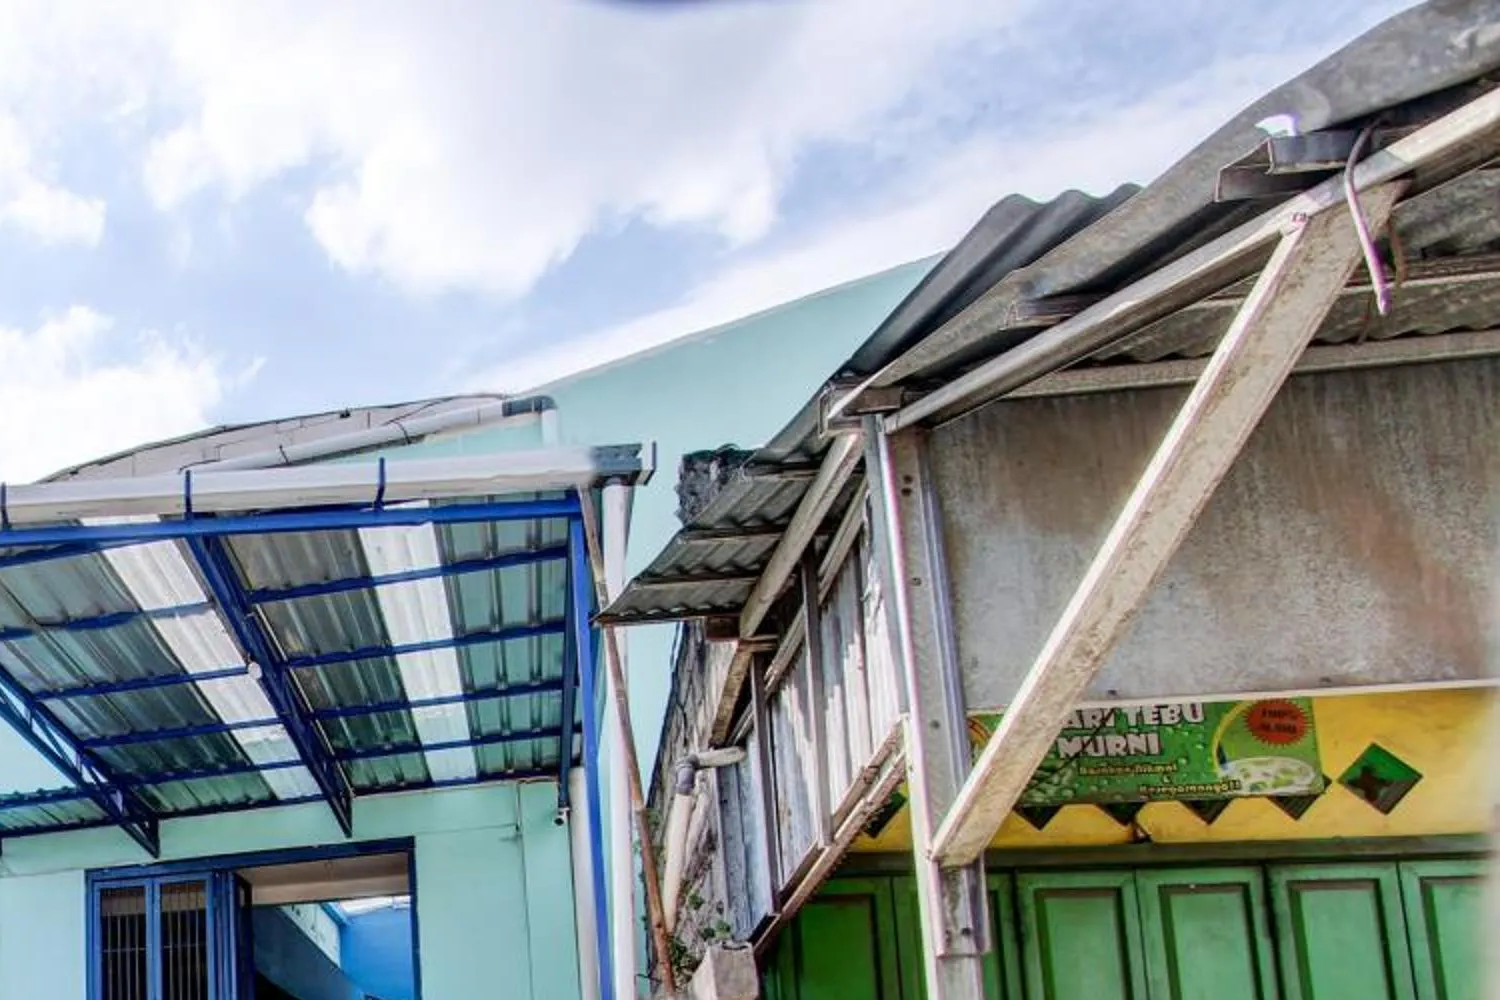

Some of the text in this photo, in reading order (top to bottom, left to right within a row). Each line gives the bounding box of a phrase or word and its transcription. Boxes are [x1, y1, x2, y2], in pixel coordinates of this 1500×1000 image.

[1060, 703, 1206, 728] ARI TEBU
[1057, 733, 1161, 759] MURNI
